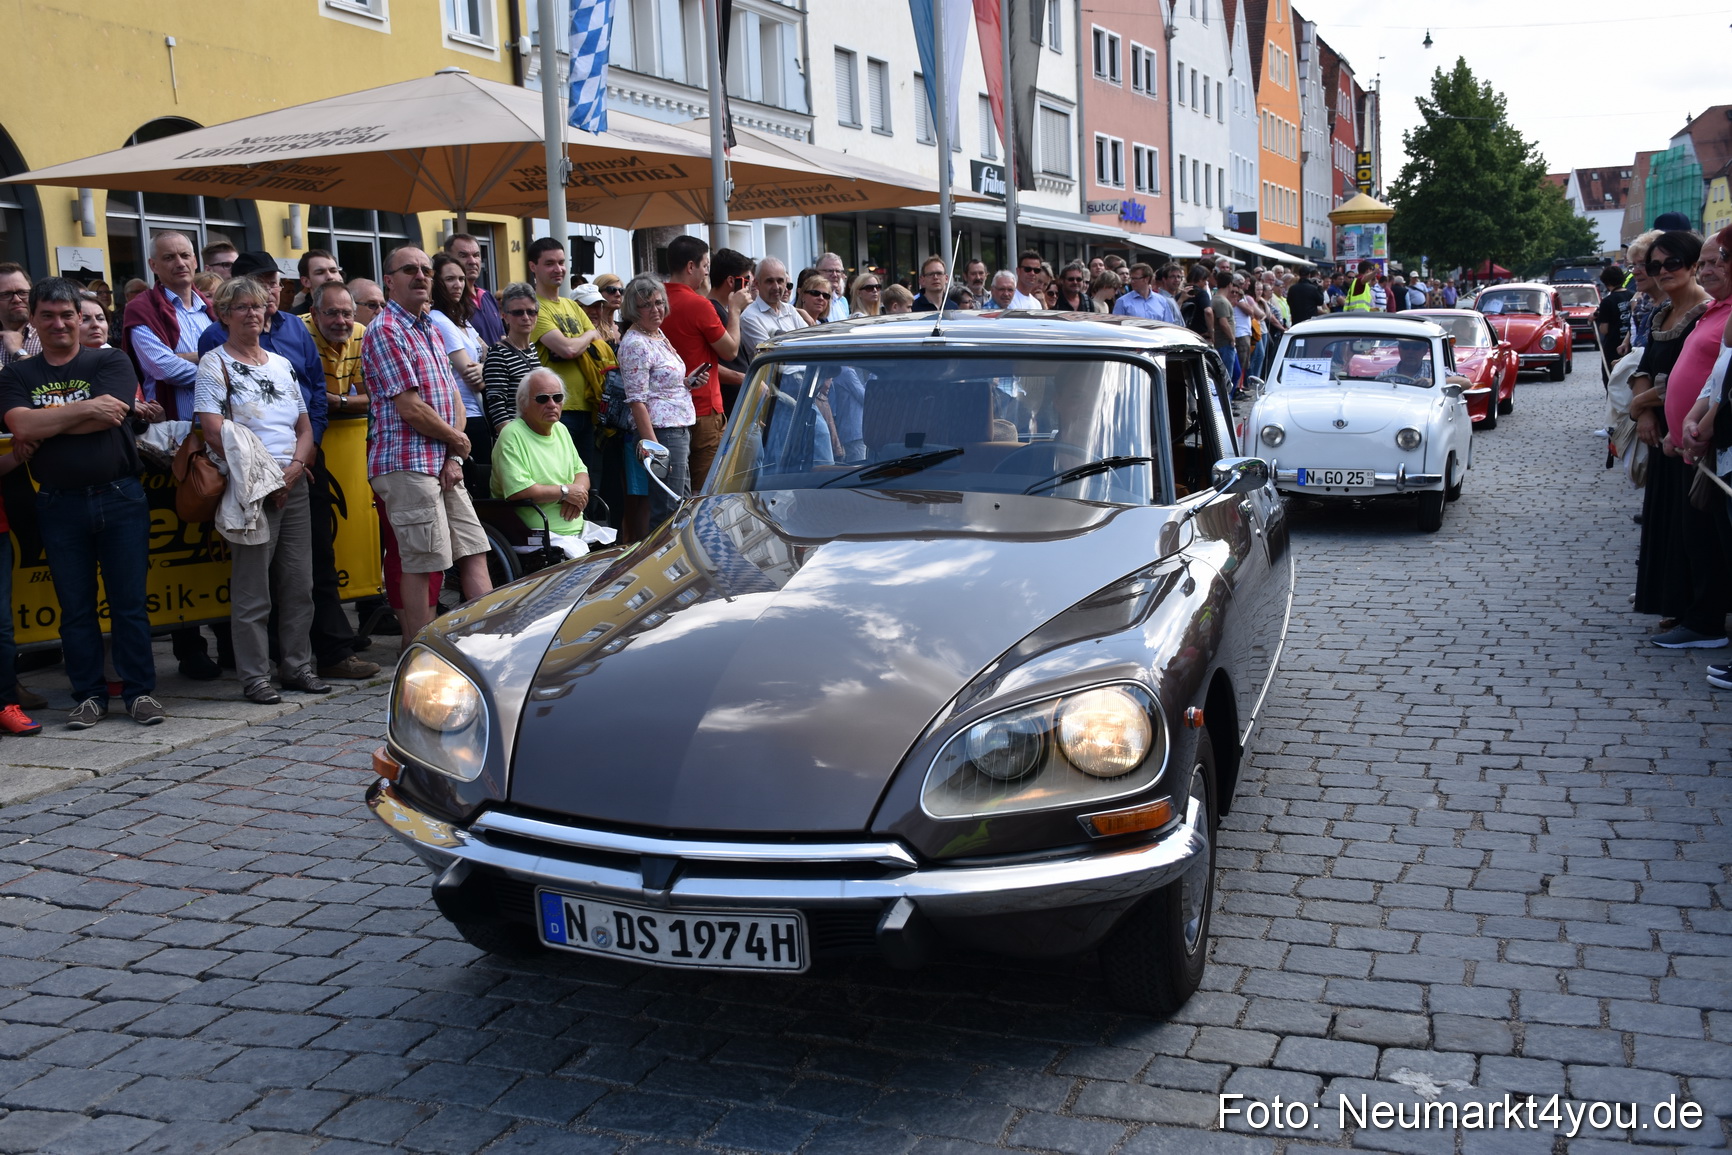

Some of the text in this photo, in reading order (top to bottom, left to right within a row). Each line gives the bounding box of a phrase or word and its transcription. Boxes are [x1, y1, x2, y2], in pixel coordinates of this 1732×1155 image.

[172, 133, 389, 160] Lammsbräu
[1306, 471, 1364, 485] N GO 25
[564, 902, 797, 963] N DS 1974H
